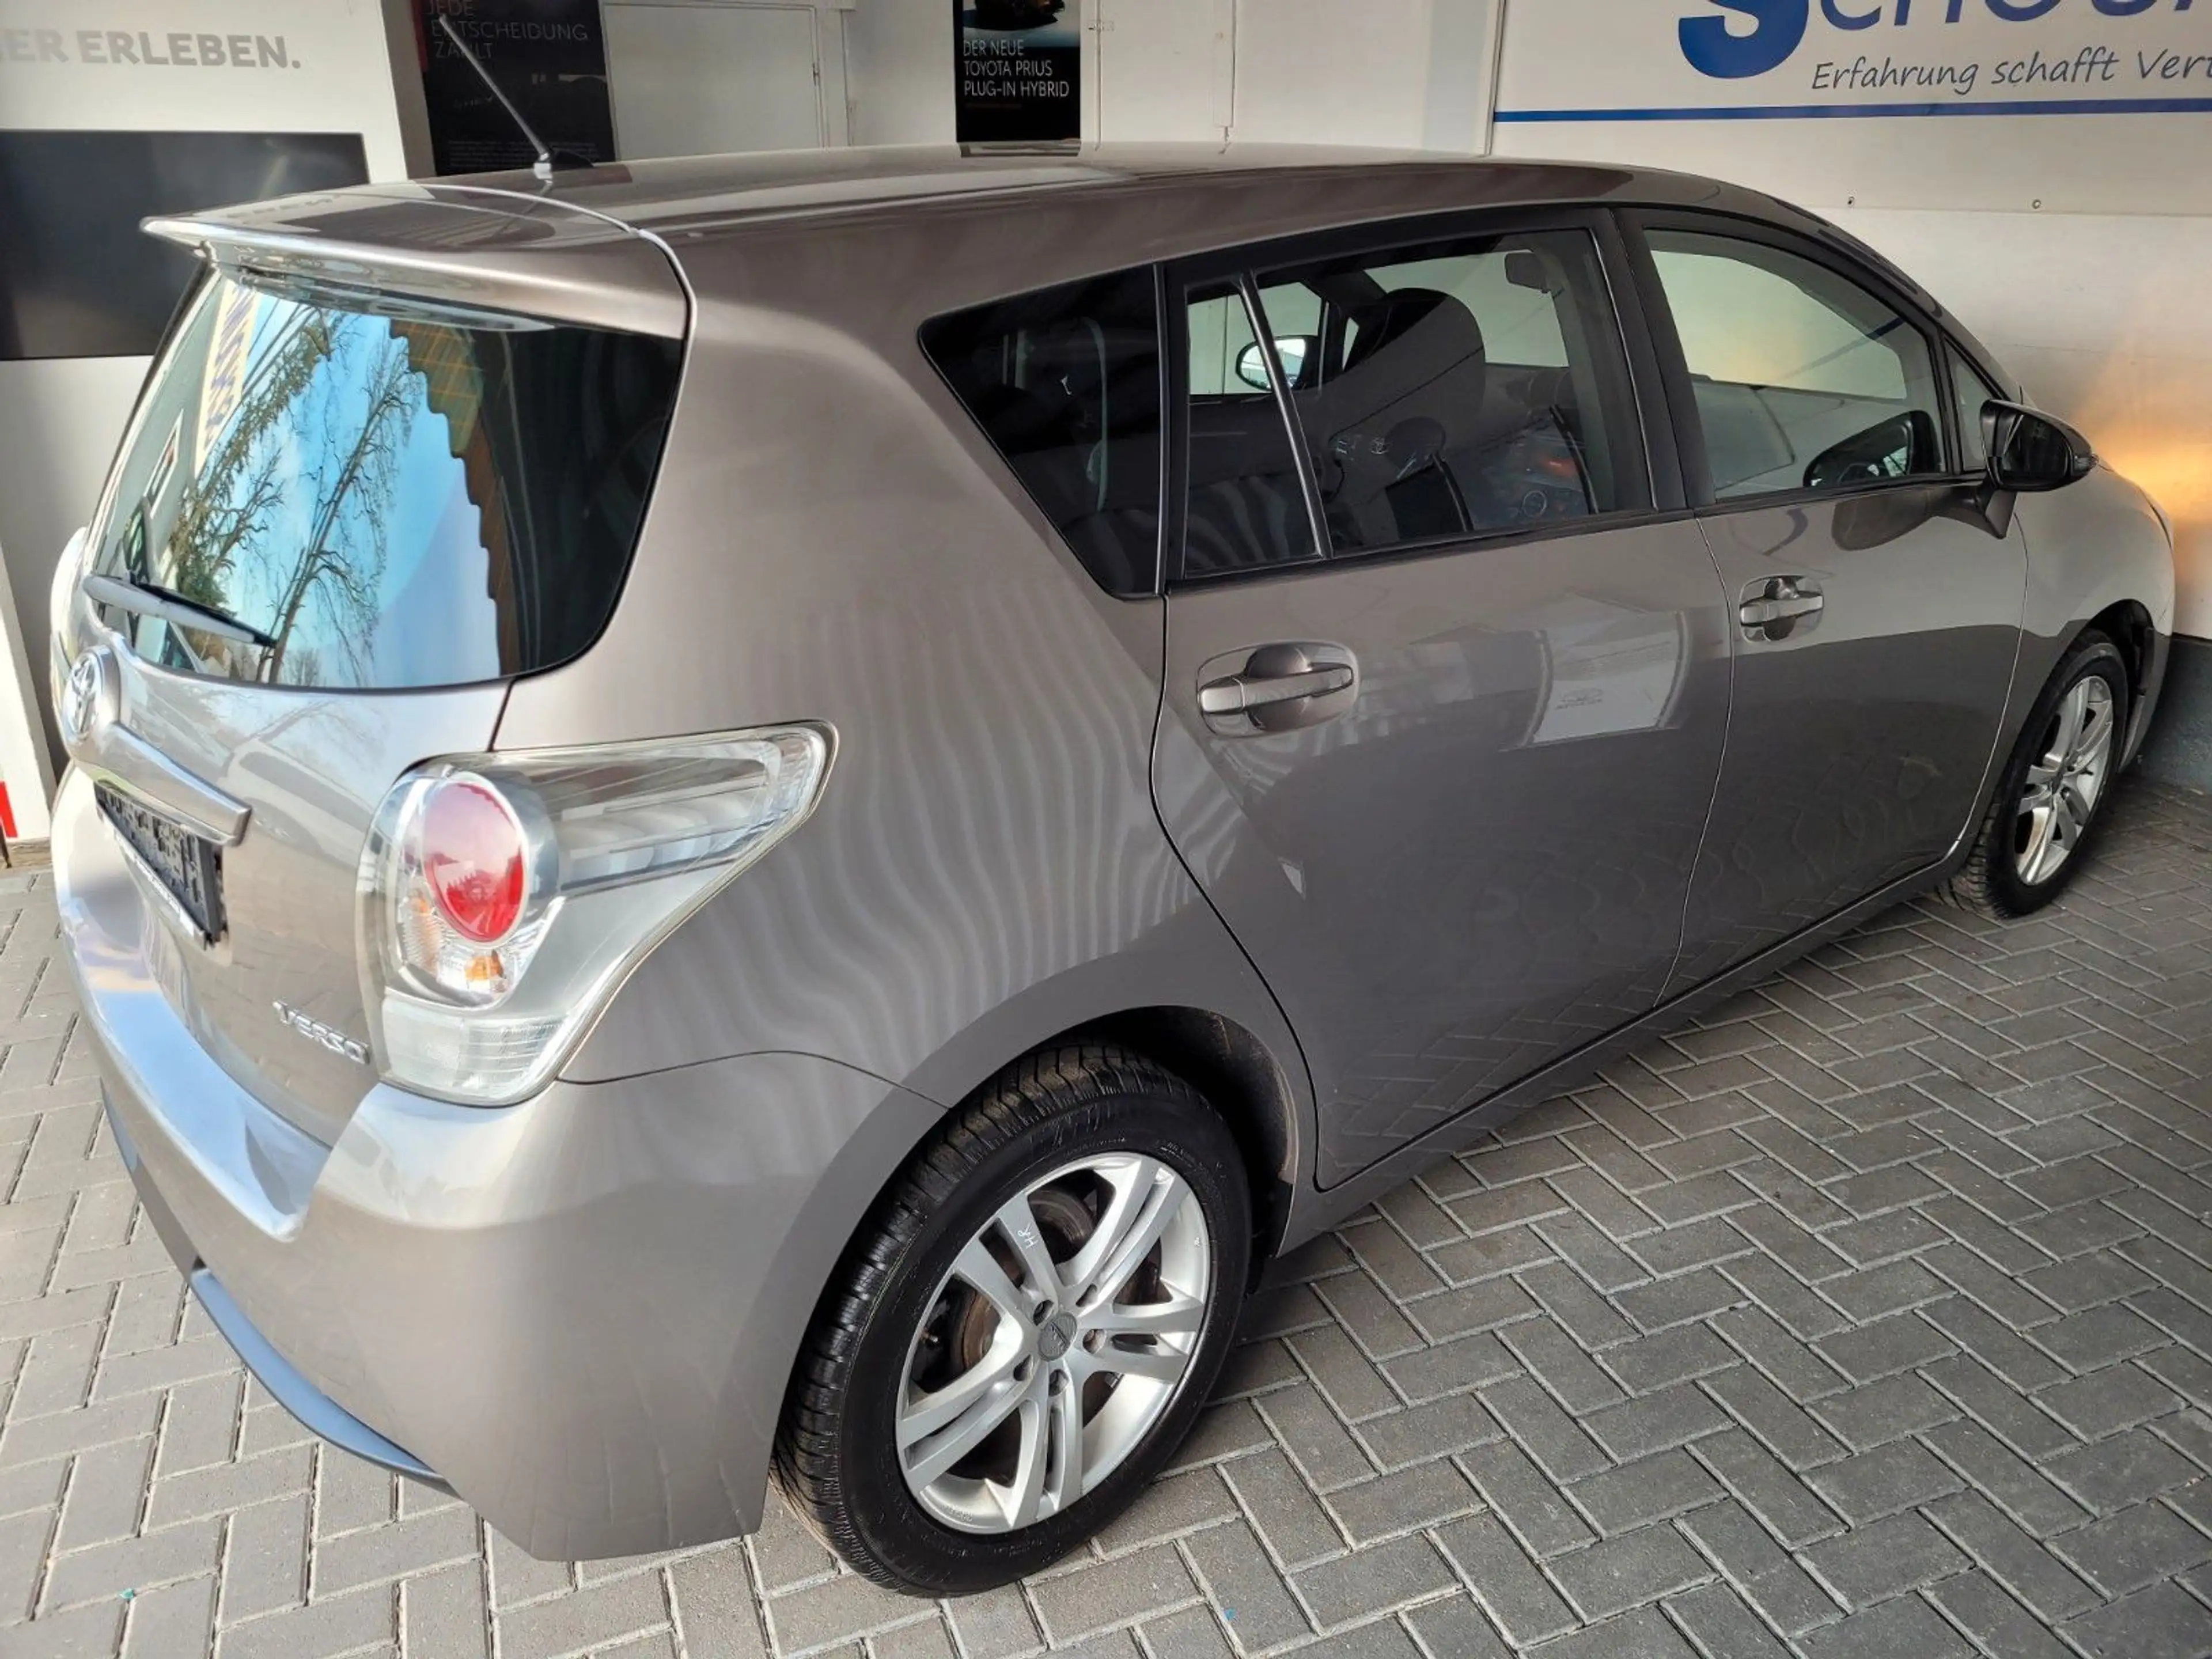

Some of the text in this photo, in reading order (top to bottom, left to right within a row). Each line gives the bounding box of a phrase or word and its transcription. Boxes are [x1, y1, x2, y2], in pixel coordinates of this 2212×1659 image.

[428, 0, 474, 16] JEDE
[0, 28, 301, 69] ER ERLEBEN.
[963, 39, 1025, 56] DER NEUE
[964, 60, 1053, 77] TOYOTA PRIUS
[1812, 56, 1979, 96] Erfahrung
[1991, 46, 2120, 84] schafft
[964, 80, 1070, 97] PLUG-IN HYBRID
